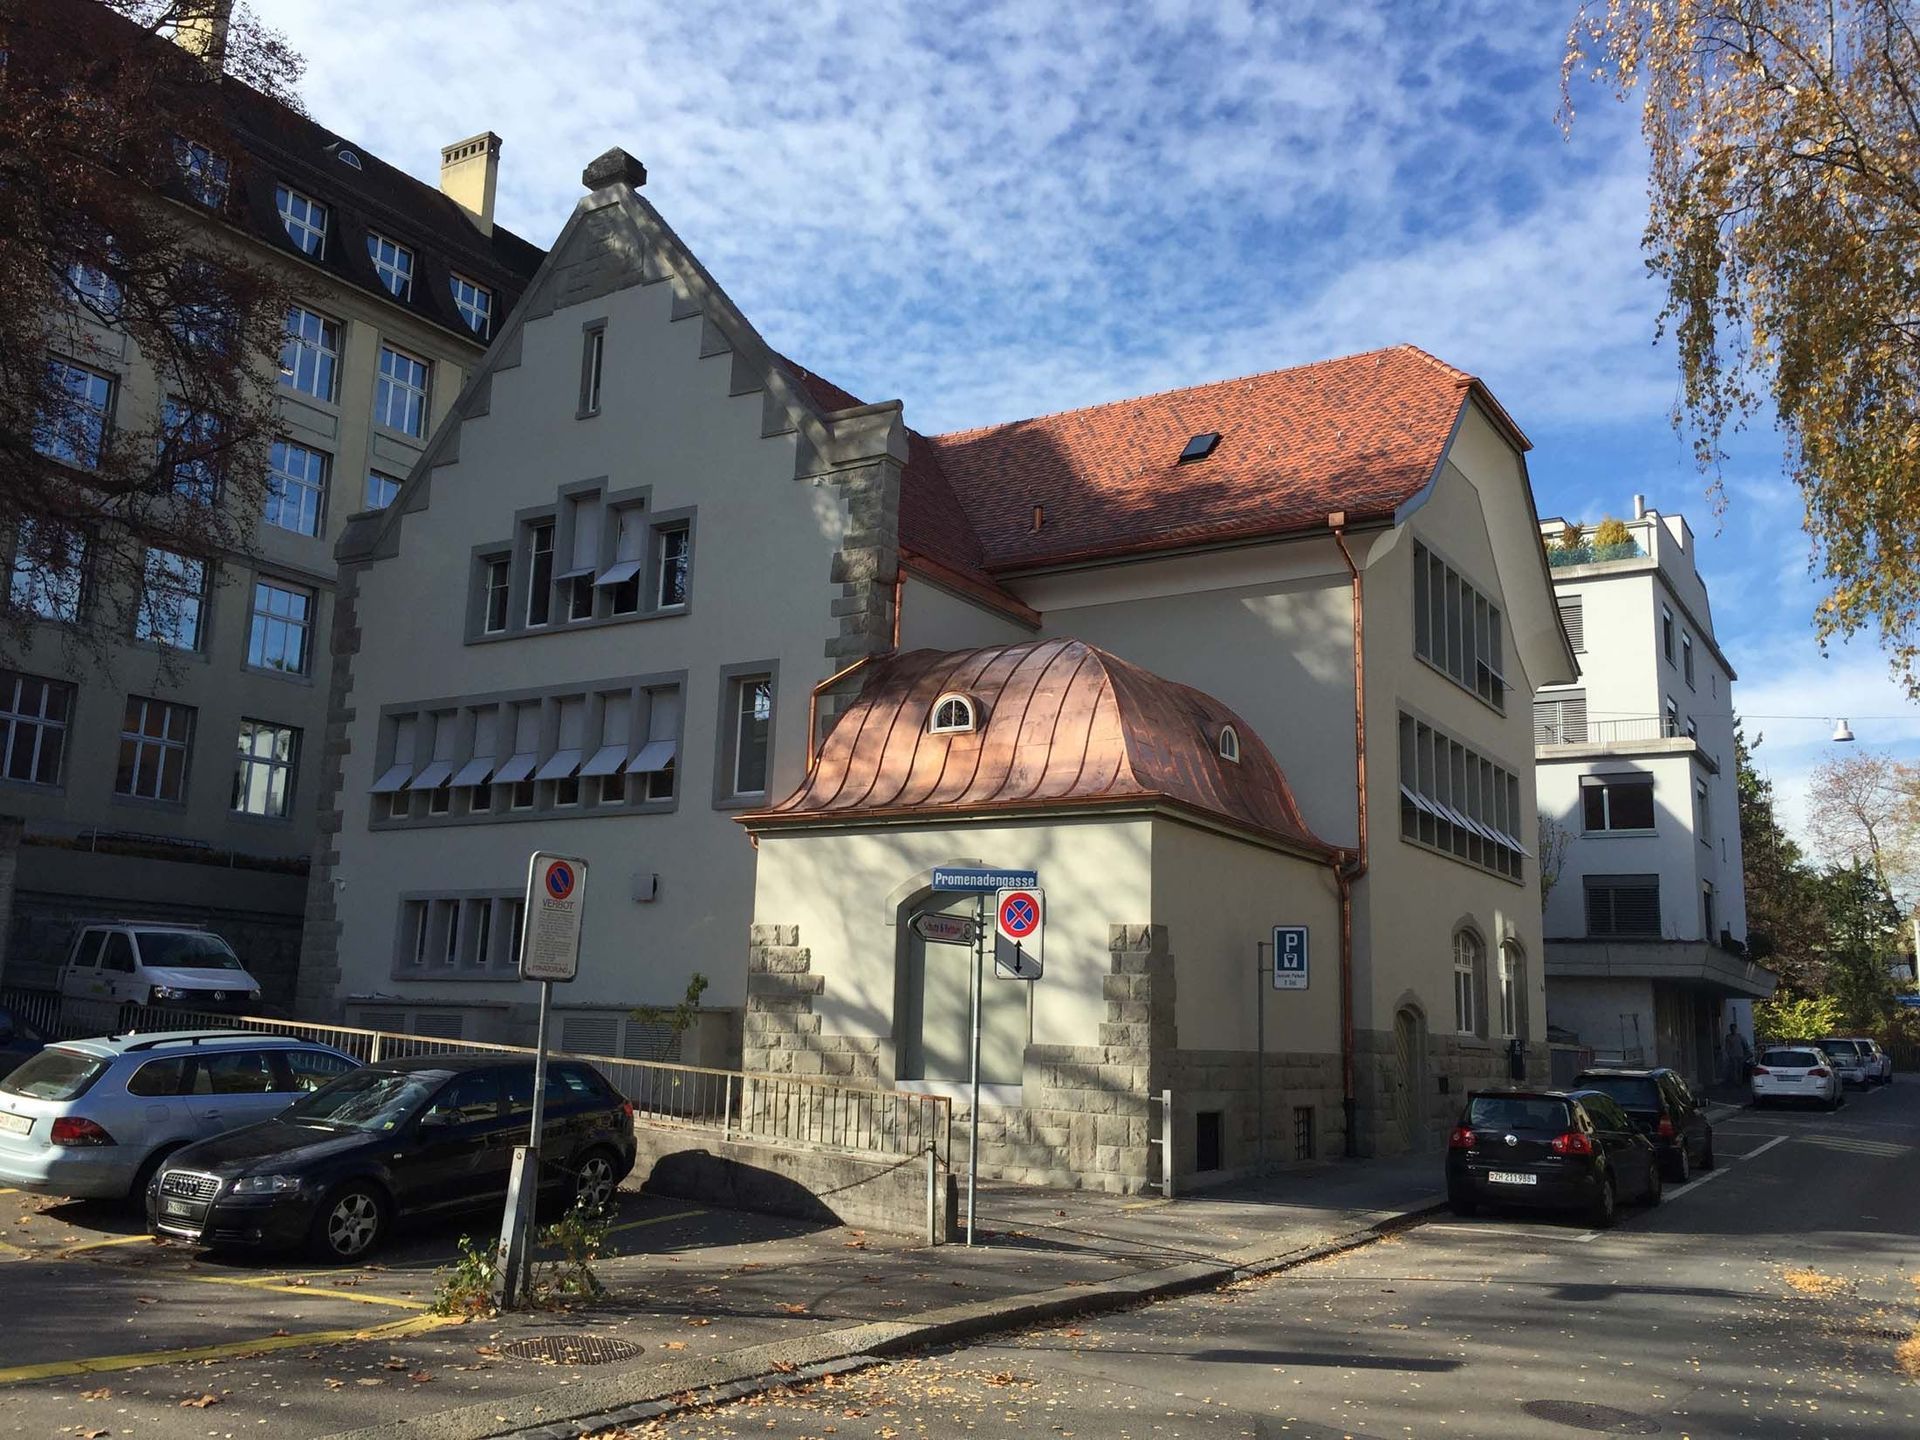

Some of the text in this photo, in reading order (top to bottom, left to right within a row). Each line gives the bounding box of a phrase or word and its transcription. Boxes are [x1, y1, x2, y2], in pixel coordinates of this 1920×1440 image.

[935, 872, 1035, 888] Promenadengasse
[543, 898, 575, 910] VERBOT
[1286, 933, 1298, 953] P
